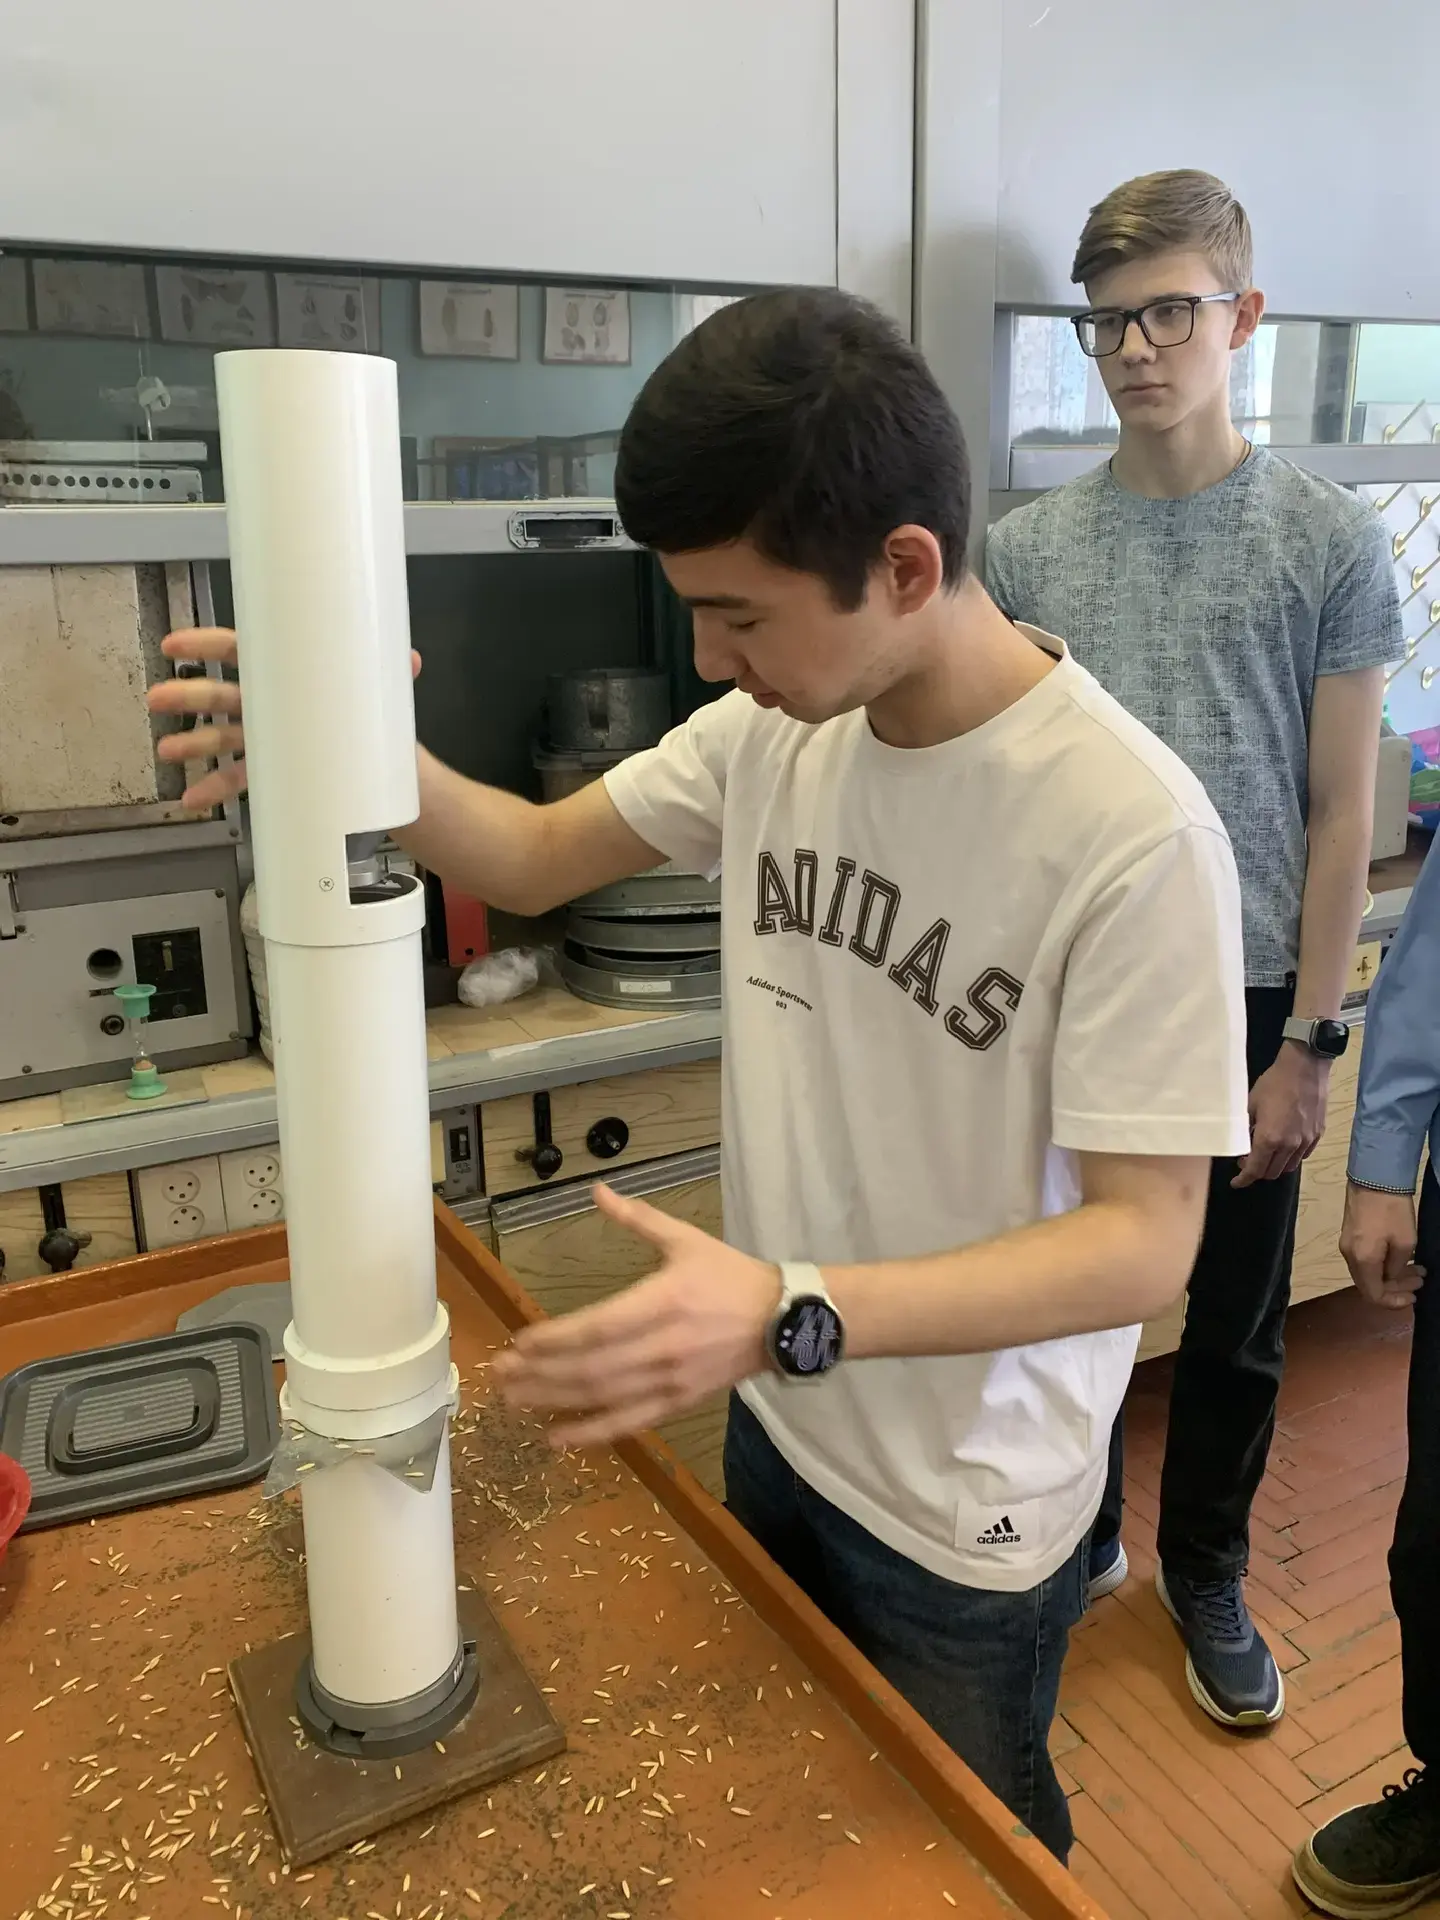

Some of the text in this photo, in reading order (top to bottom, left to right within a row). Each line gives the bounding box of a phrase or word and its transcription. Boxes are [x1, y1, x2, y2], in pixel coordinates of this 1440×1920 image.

[753, 848, 1025, 1051] ADIDAS
[746, 975, 813, 1012] Adidas Sportswear
[976, 1533, 1021, 1544] adidas
